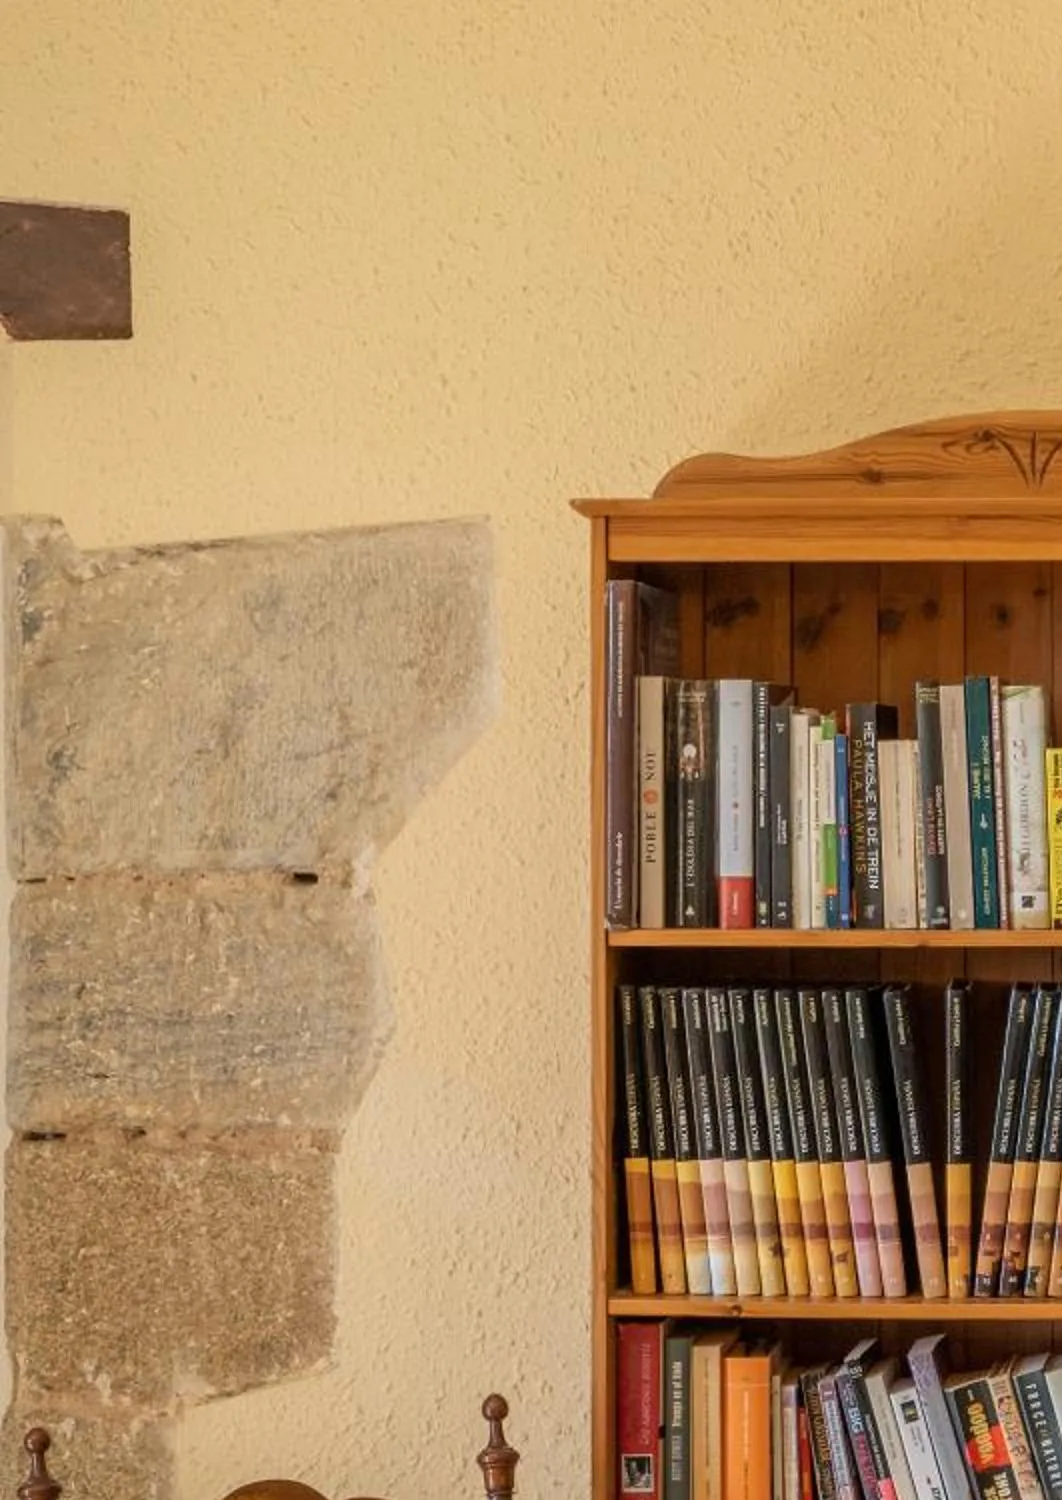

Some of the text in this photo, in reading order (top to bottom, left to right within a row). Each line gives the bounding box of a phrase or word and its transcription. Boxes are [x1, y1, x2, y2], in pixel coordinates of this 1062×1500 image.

[863, 721, 876, 750] HET
[851, 739, 866, 875] PAULA HAWKINS
[866, 807, 877, 822] IN
[645, 811, 657, 863] POBLE
[867, 828, 878, 846] DE
[868, 849, 880, 889] TREIN
[1024, 1382, 1048, 1428] FORCE
